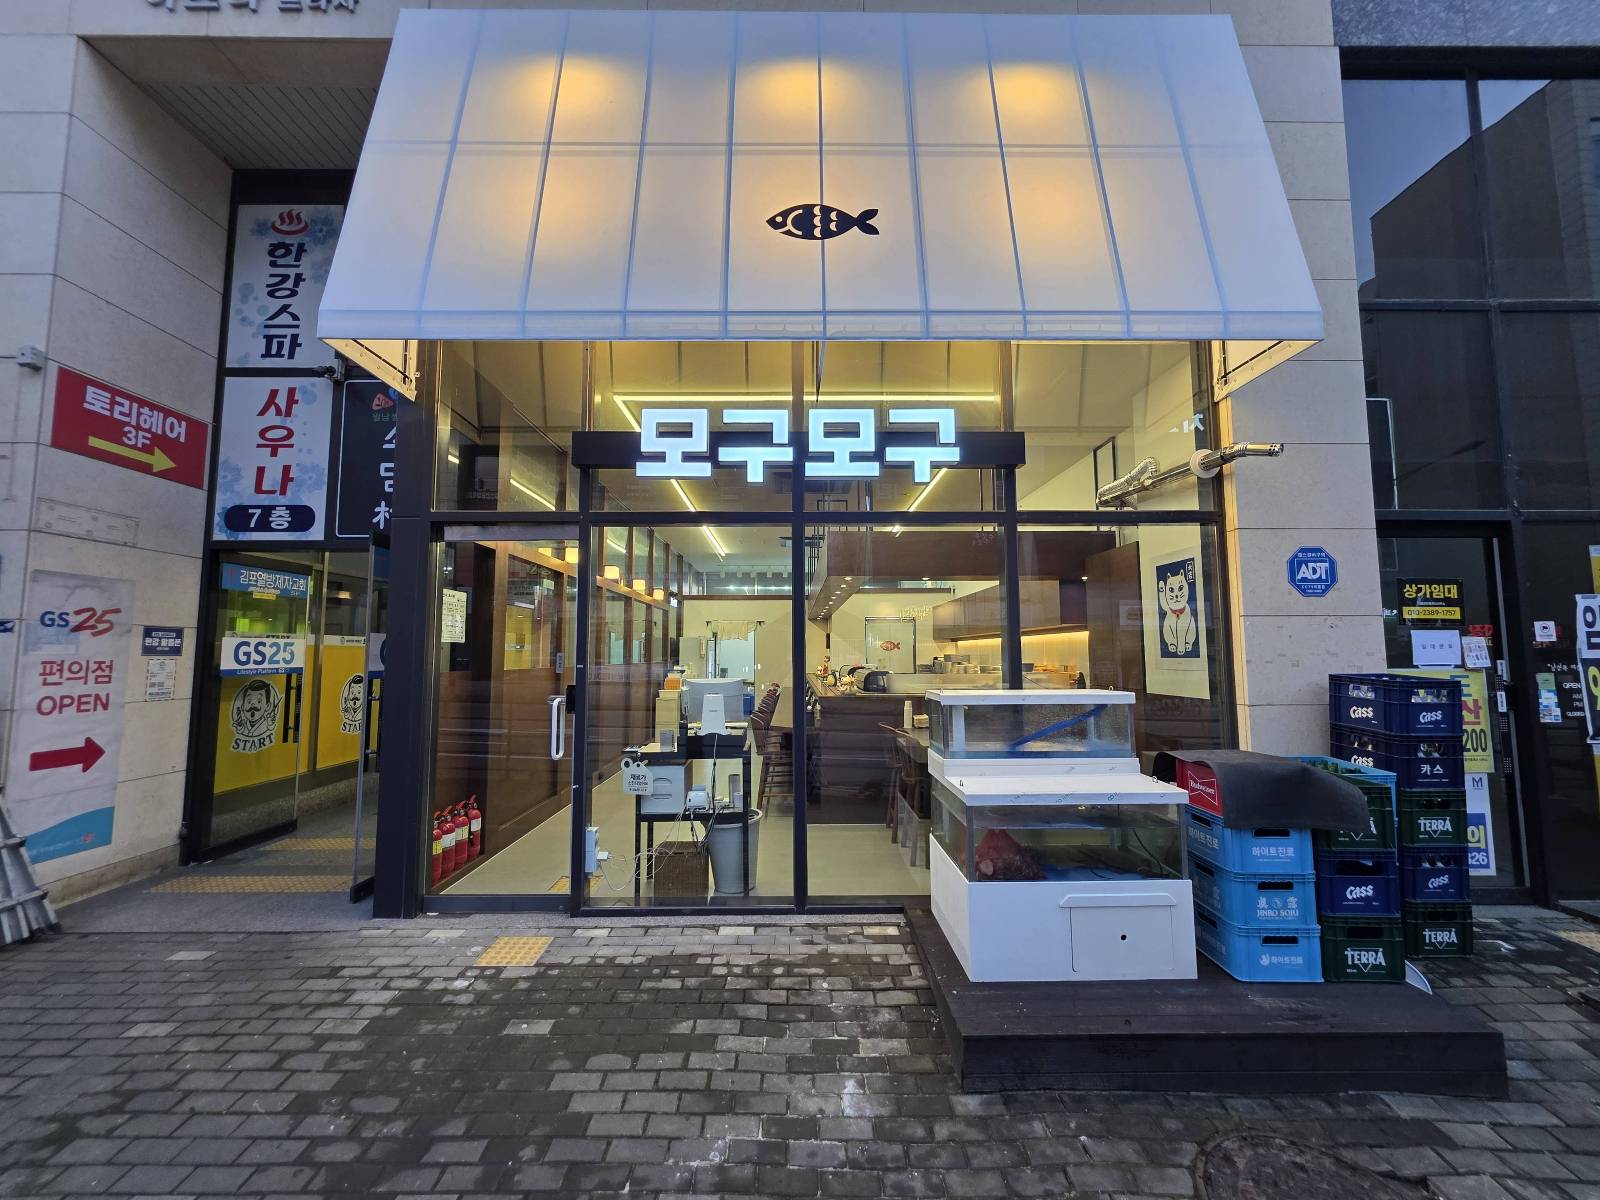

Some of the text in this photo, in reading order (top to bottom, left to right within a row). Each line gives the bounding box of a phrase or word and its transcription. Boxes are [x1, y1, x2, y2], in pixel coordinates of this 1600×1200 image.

[260, 241, 307, 360] 한강스파
[83, 385, 187, 443] 토리헤어
[122, 426, 152, 448] 3F
[254, 386, 300, 496] 사우나
[635, 408, 961, 483] 모구모구
[240, 569, 307, 592] 김포열방제자교회
[1296, 562, 1329, 580] ADT
[1403, 583, 1458, 599] 상가임대
[39, 607, 123, 637] GS25
[1407, 609, 1457, 617] 010-2389-1757
[233, 640, 295, 667] GS25
[39, 659, 114, 687] 편의점
[36, 692, 110, 716] OPEN
[1349, 705, 1375, 719] Cass
[1419, 710, 1443, 723] Cass
[232, 733, 275, 752] START
[1417, 816, 1453, 832] TERRA
[1251, 846, 1295, 857] 하이트진로
[1428, 874, 1449, 889] Cass
[1345, 884, 1375, 900] Cass
[1422, 928, 1458, 944] TERRA
[1344, 947, 1387, 966] TERRA
